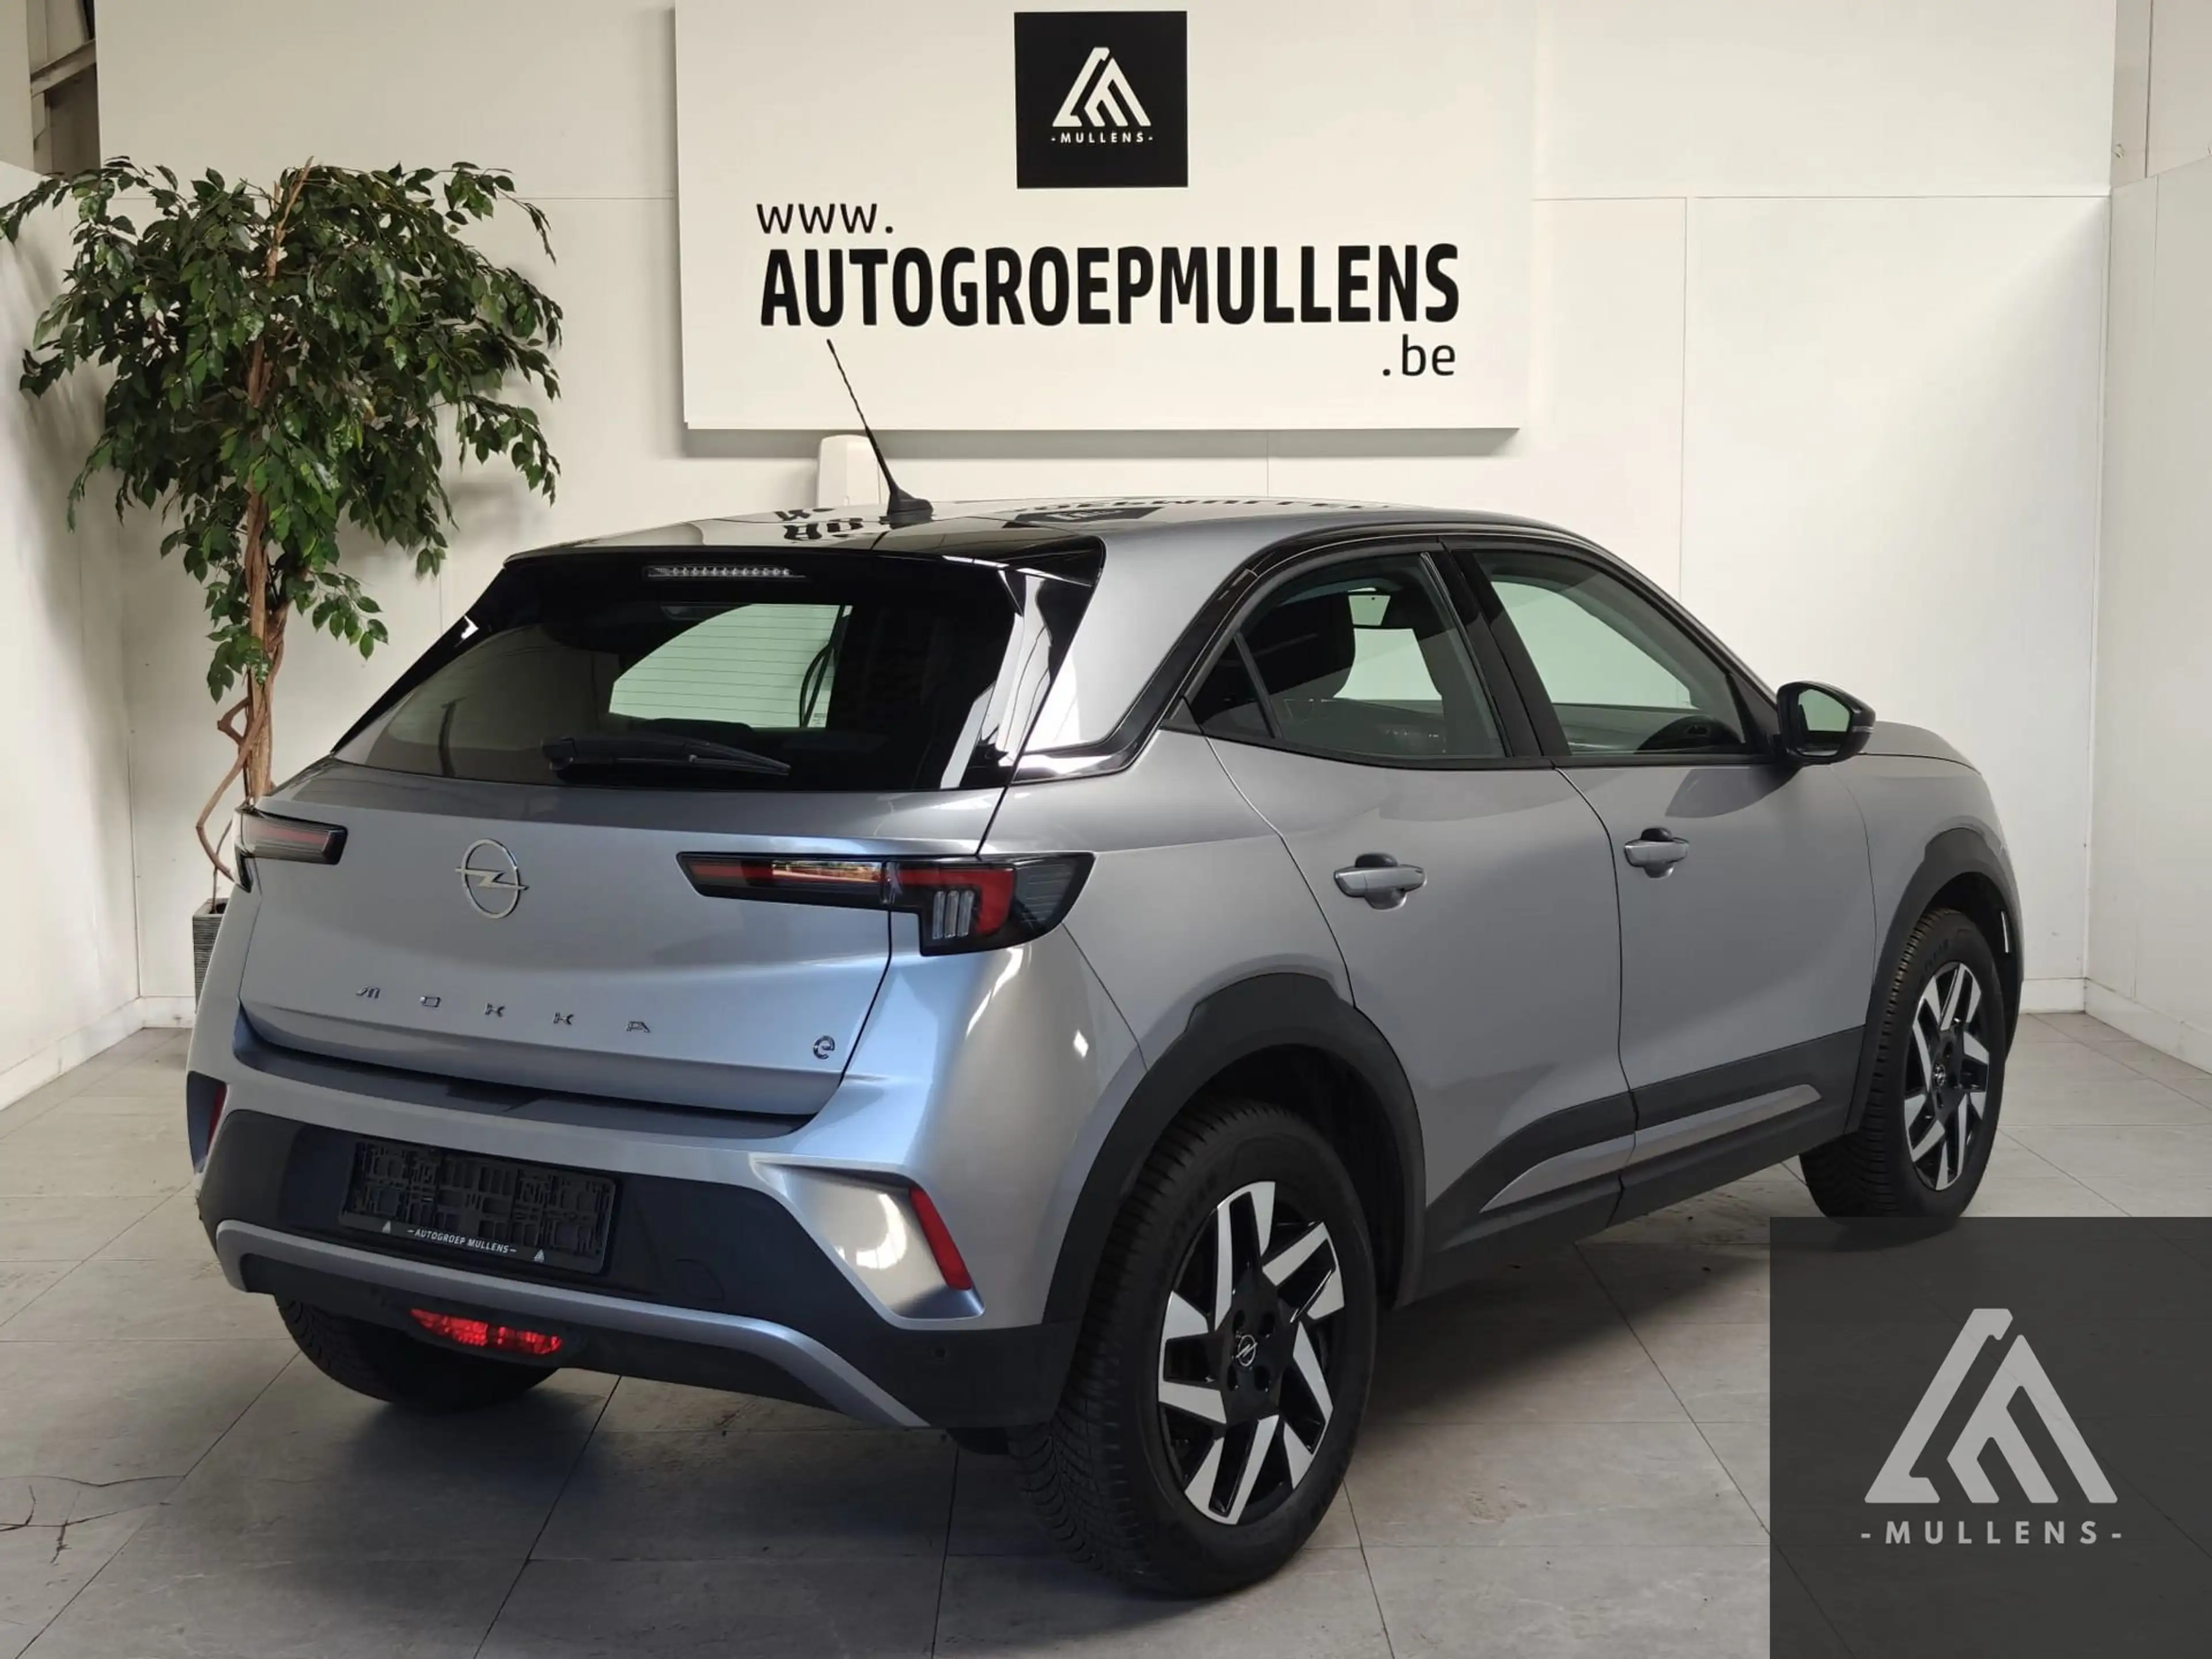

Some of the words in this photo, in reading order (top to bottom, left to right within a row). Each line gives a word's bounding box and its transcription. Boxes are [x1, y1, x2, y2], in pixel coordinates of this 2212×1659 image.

[756, 203, 895, 235] www.
[761, 243, 1460, 328] AUTOGROEPMULLENS
[1382, 334, 1456, 377] .be
[355, 986, 652, 1033] MOKKA
[813, 1035, 835, 1060] e
